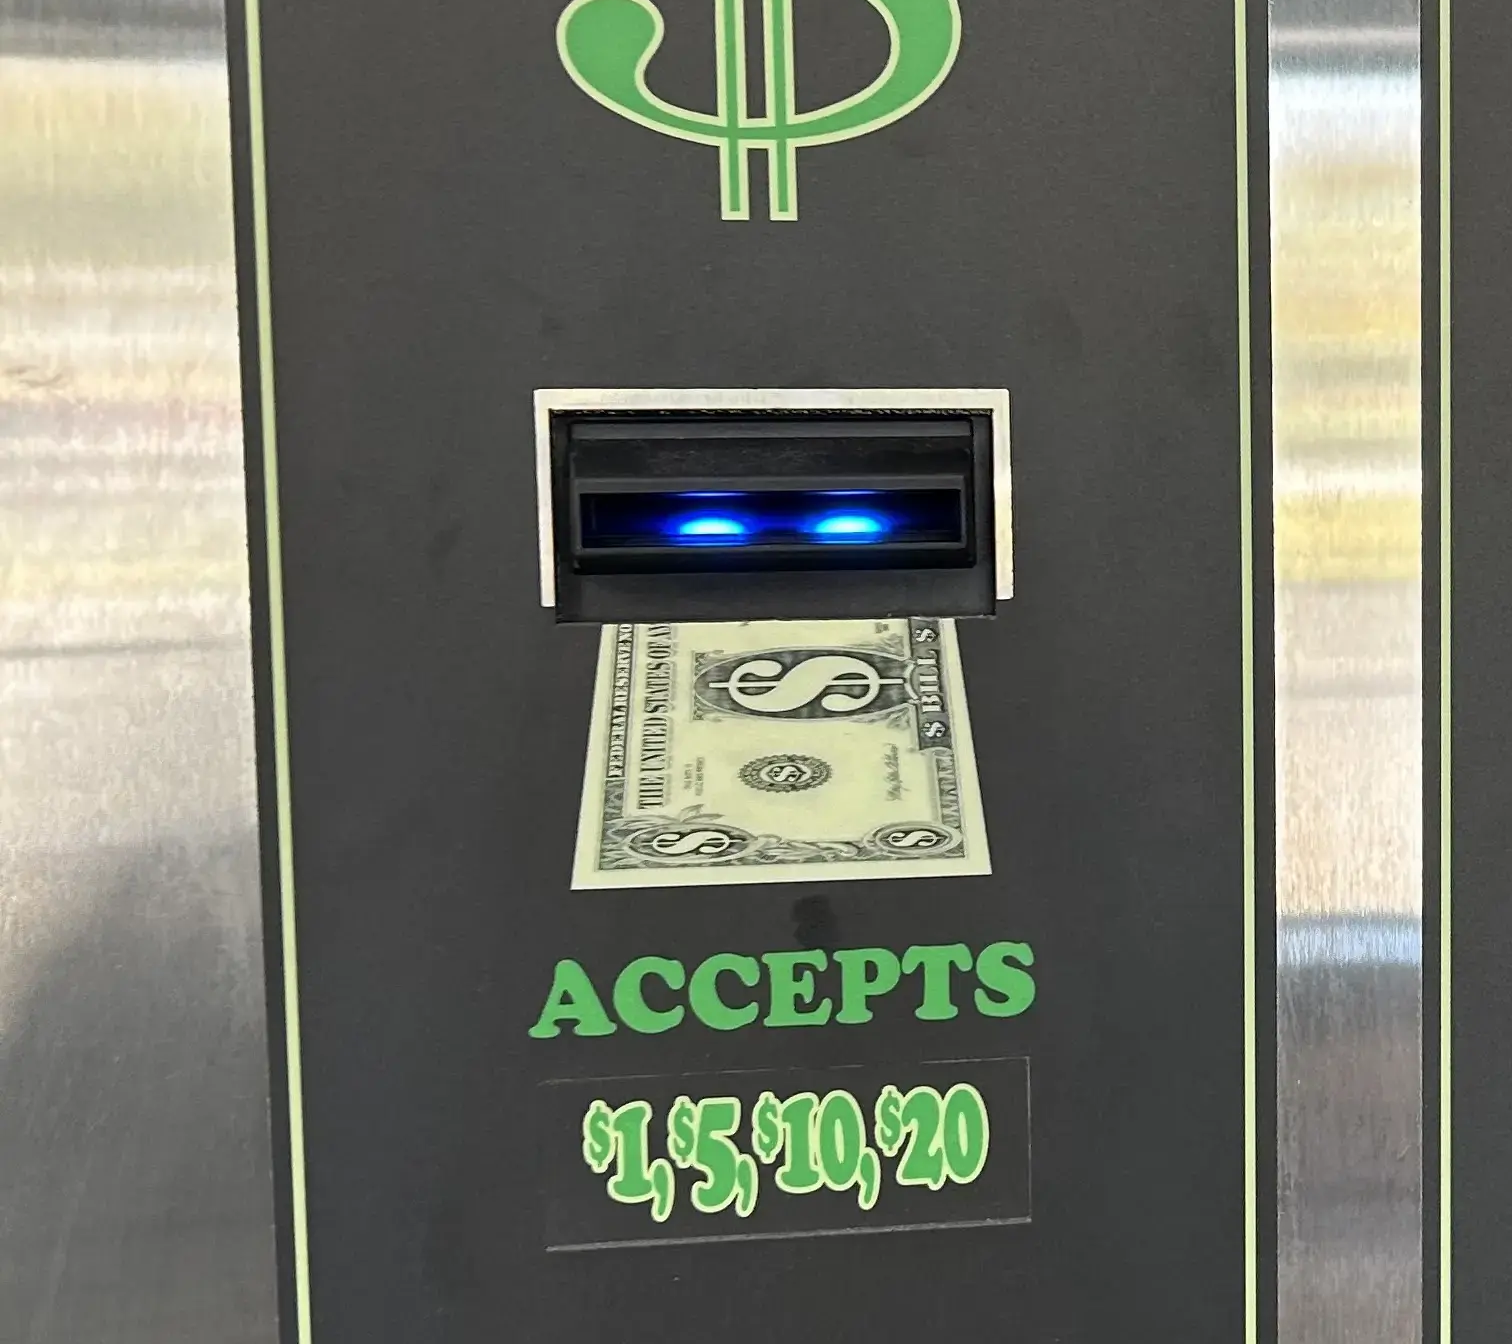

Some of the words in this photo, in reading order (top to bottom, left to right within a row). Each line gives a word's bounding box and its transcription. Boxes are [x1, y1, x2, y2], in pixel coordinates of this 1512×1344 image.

[612, 642, 631, 705] RESERVE
[646, 642, 672, 660] OF
[642, 662, 670, 714] STATES
[916, 650, 943, 714] BILL
[607, 705, 626, 777] FEDERAL
[639, 717, 668, 773] UNITED
[637, 776, 664, 810] THE
[528, 940, 1036, 1039] ACCEPTS
